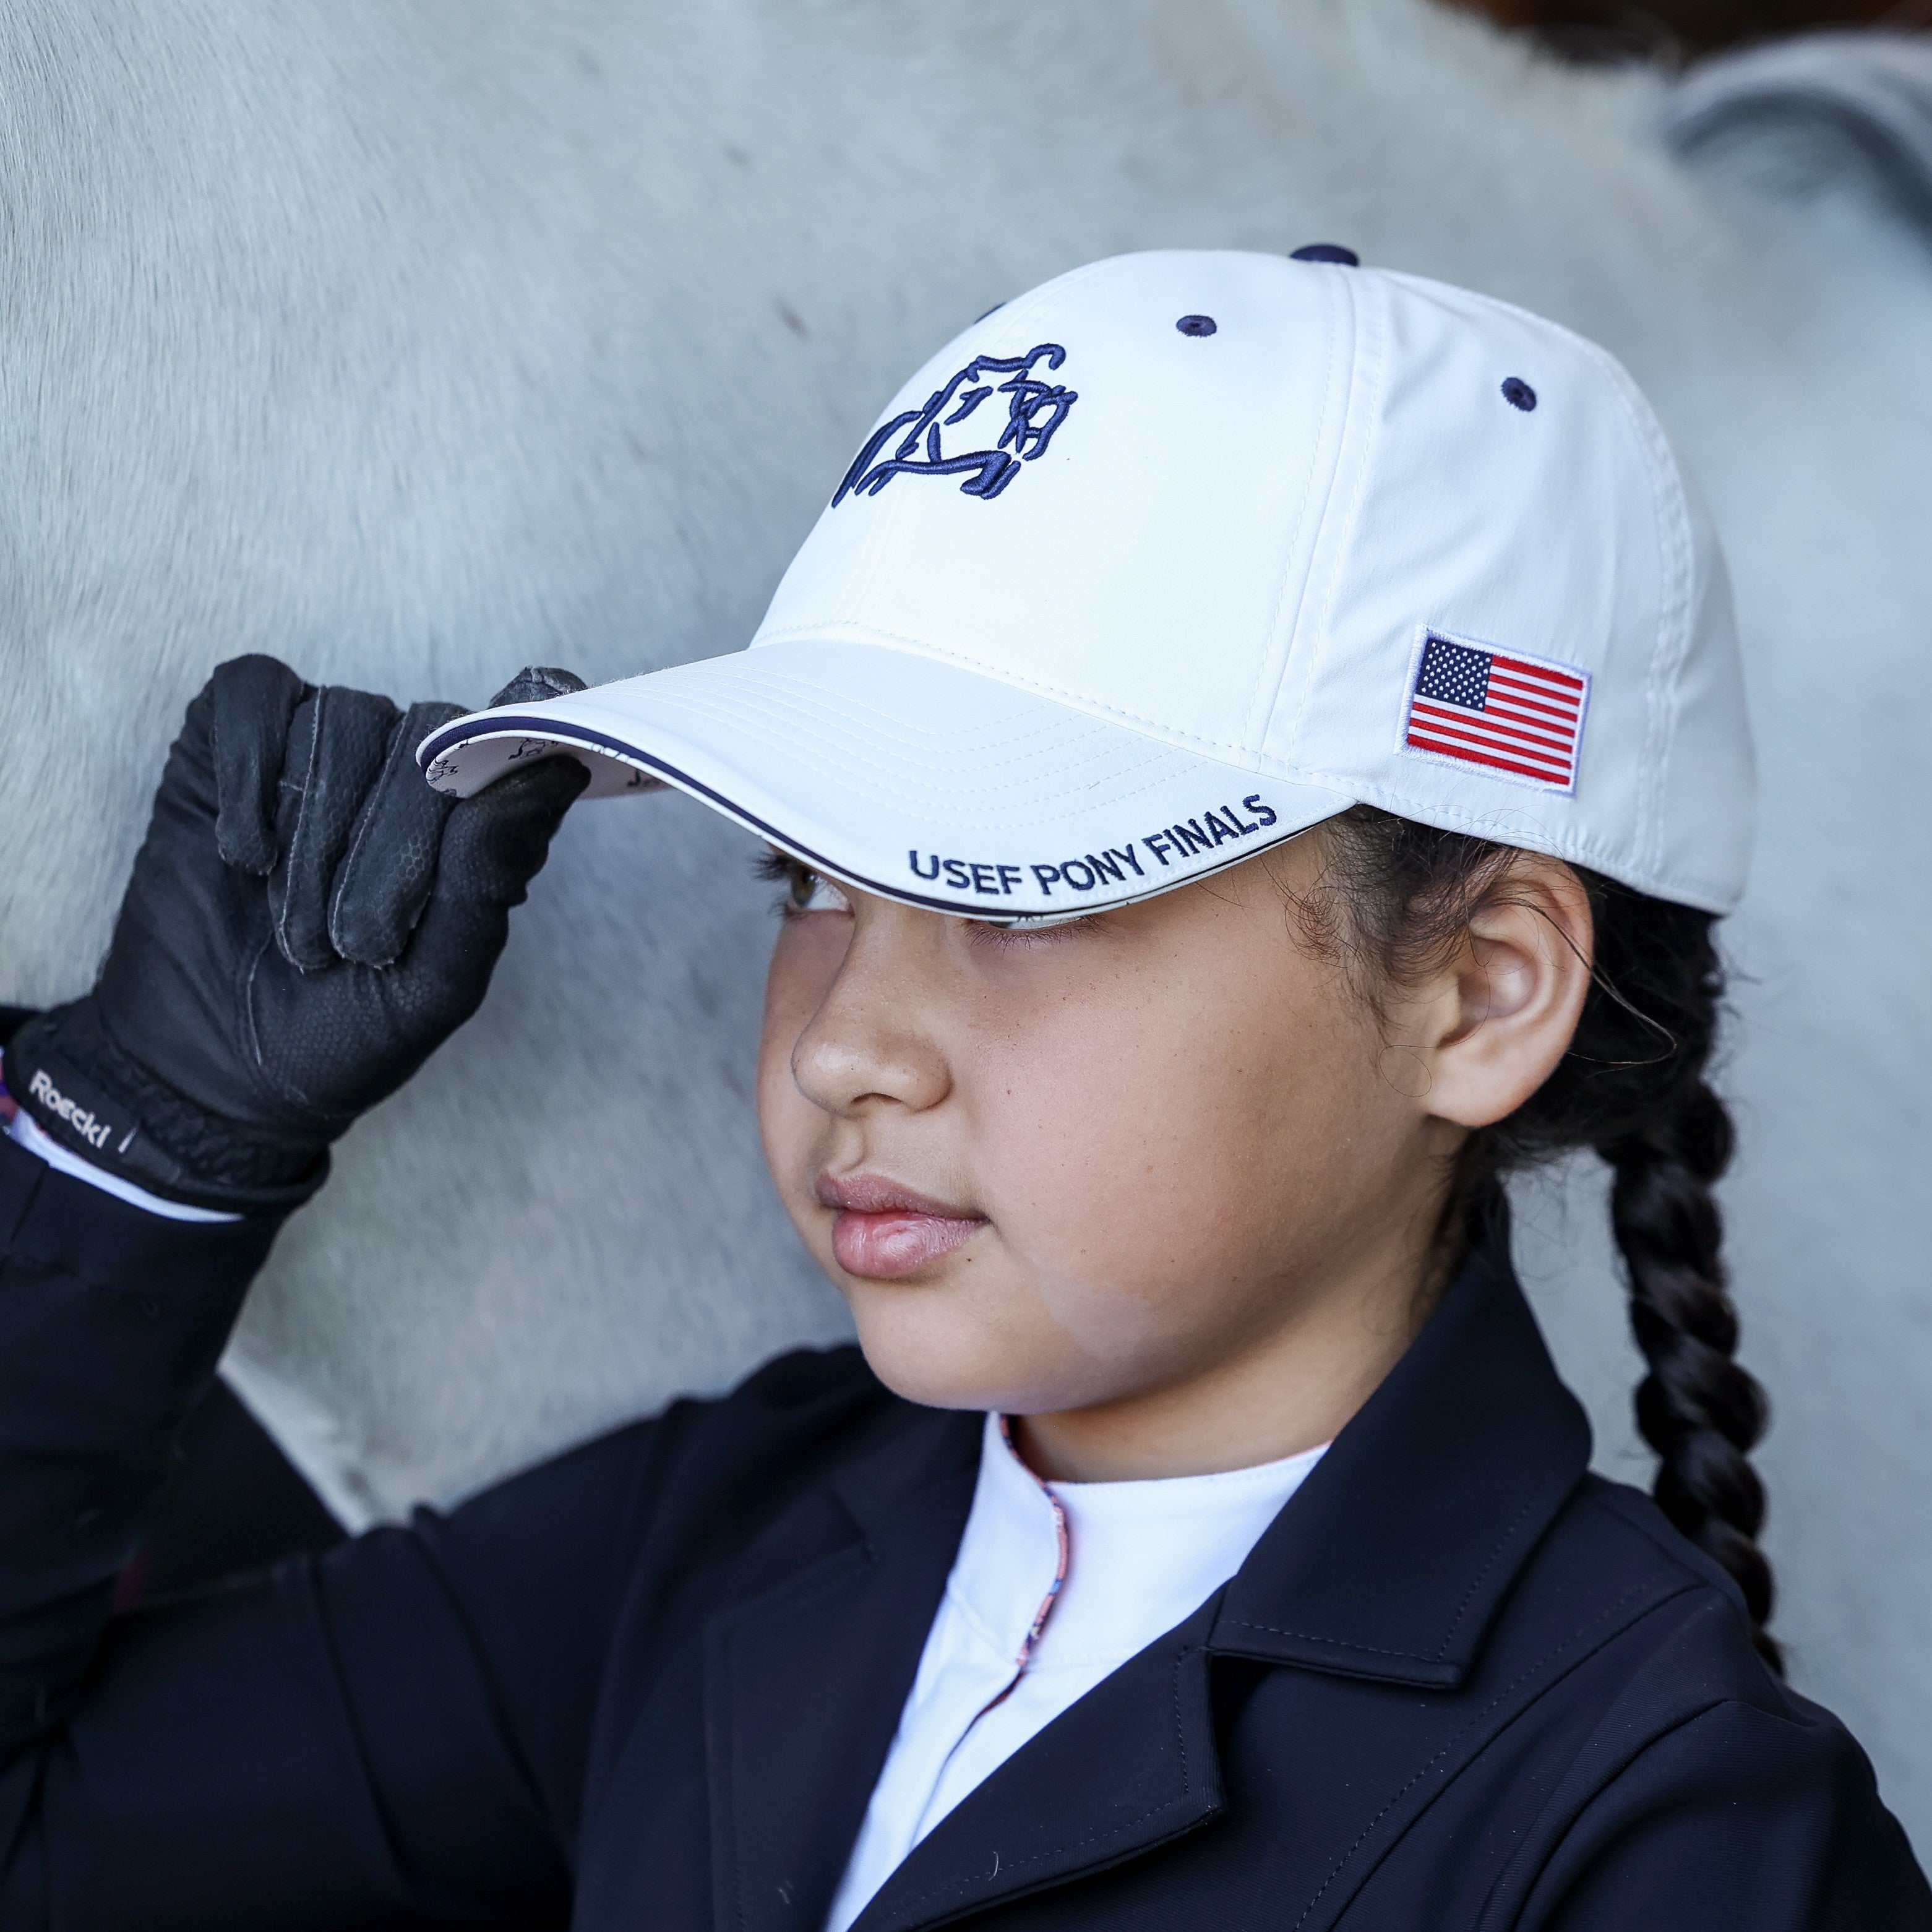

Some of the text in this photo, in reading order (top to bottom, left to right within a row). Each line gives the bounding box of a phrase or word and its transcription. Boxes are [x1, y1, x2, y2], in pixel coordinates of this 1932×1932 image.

[908, 794, 1277, 896] USEF PONY FINALS
